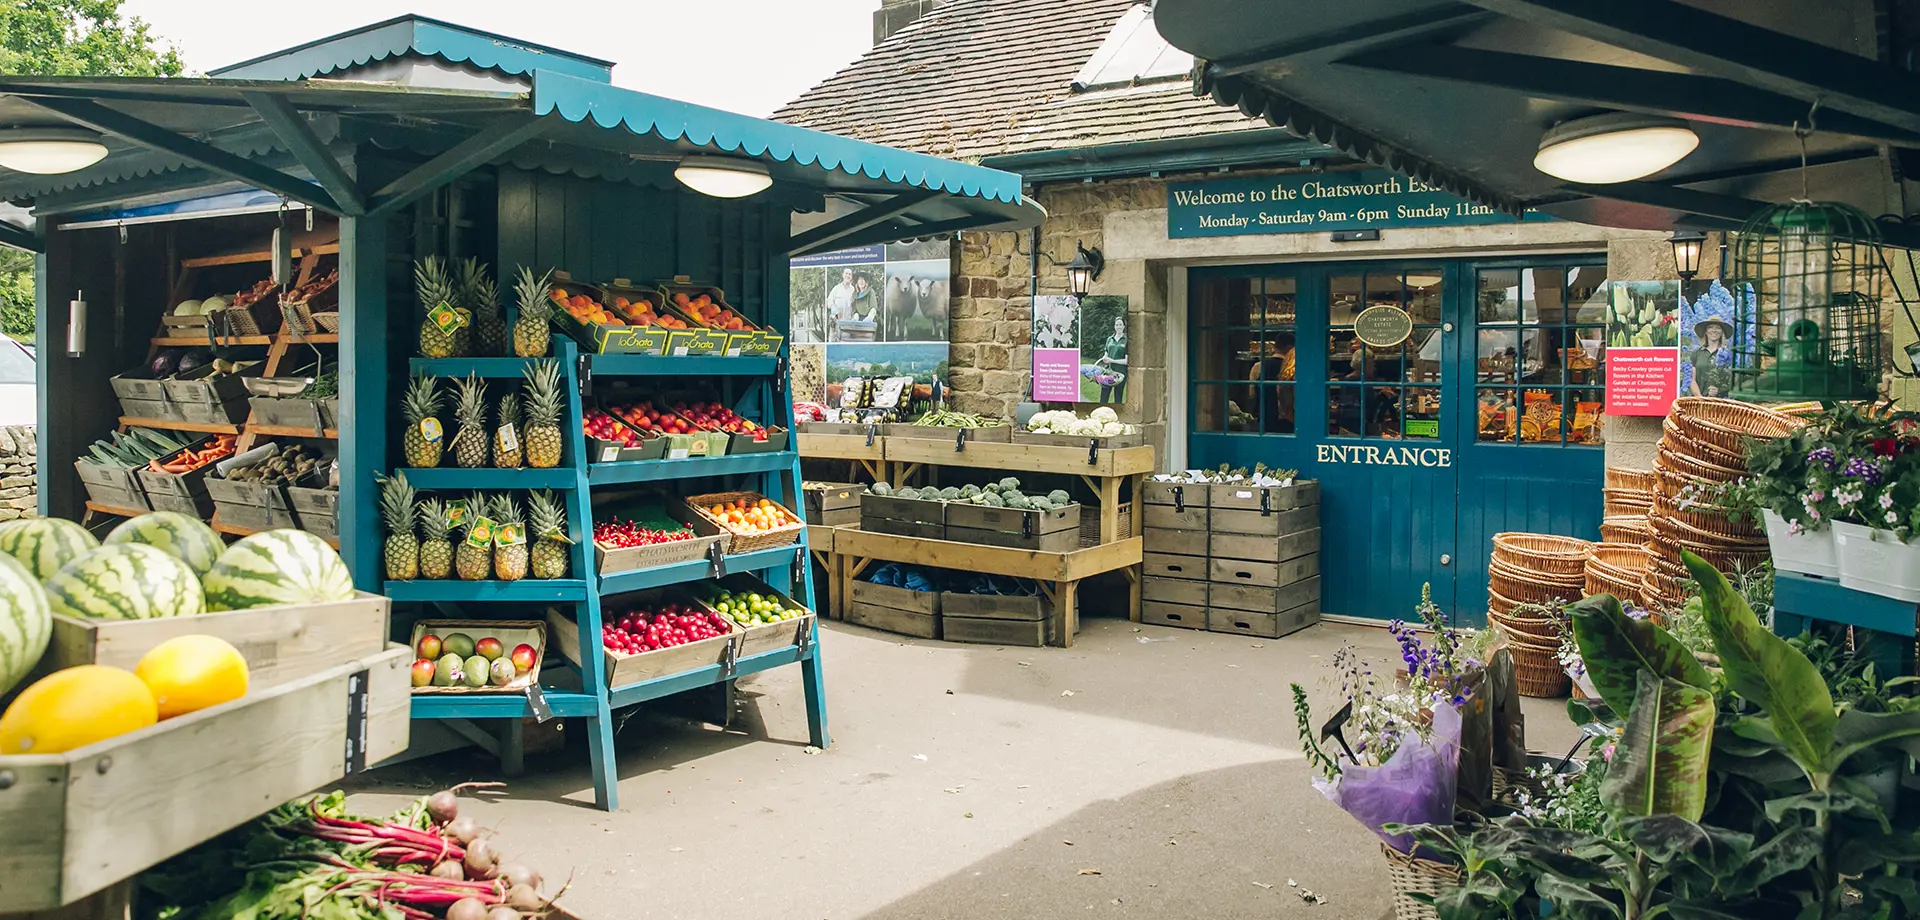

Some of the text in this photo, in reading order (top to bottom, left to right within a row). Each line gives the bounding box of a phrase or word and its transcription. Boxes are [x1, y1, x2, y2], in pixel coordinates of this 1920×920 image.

[1174, 189, 1245, 206] Welcome
[1250, 190, 1266, 202] to
[1271, 184, 1297, 200] the
[1302, 176, 1402, 199] Chatsworth
[1199, 214, 1249, 228] Monday
[1258, 210, 1315, 225] Saturday
[1318, 209, 1347, 222] 9am
[1356, 208, 1389, 222] 6pm
[1397, 204, 1450, 219] Sunday
[1316, 444, 1452, 467] ENTRANCE
